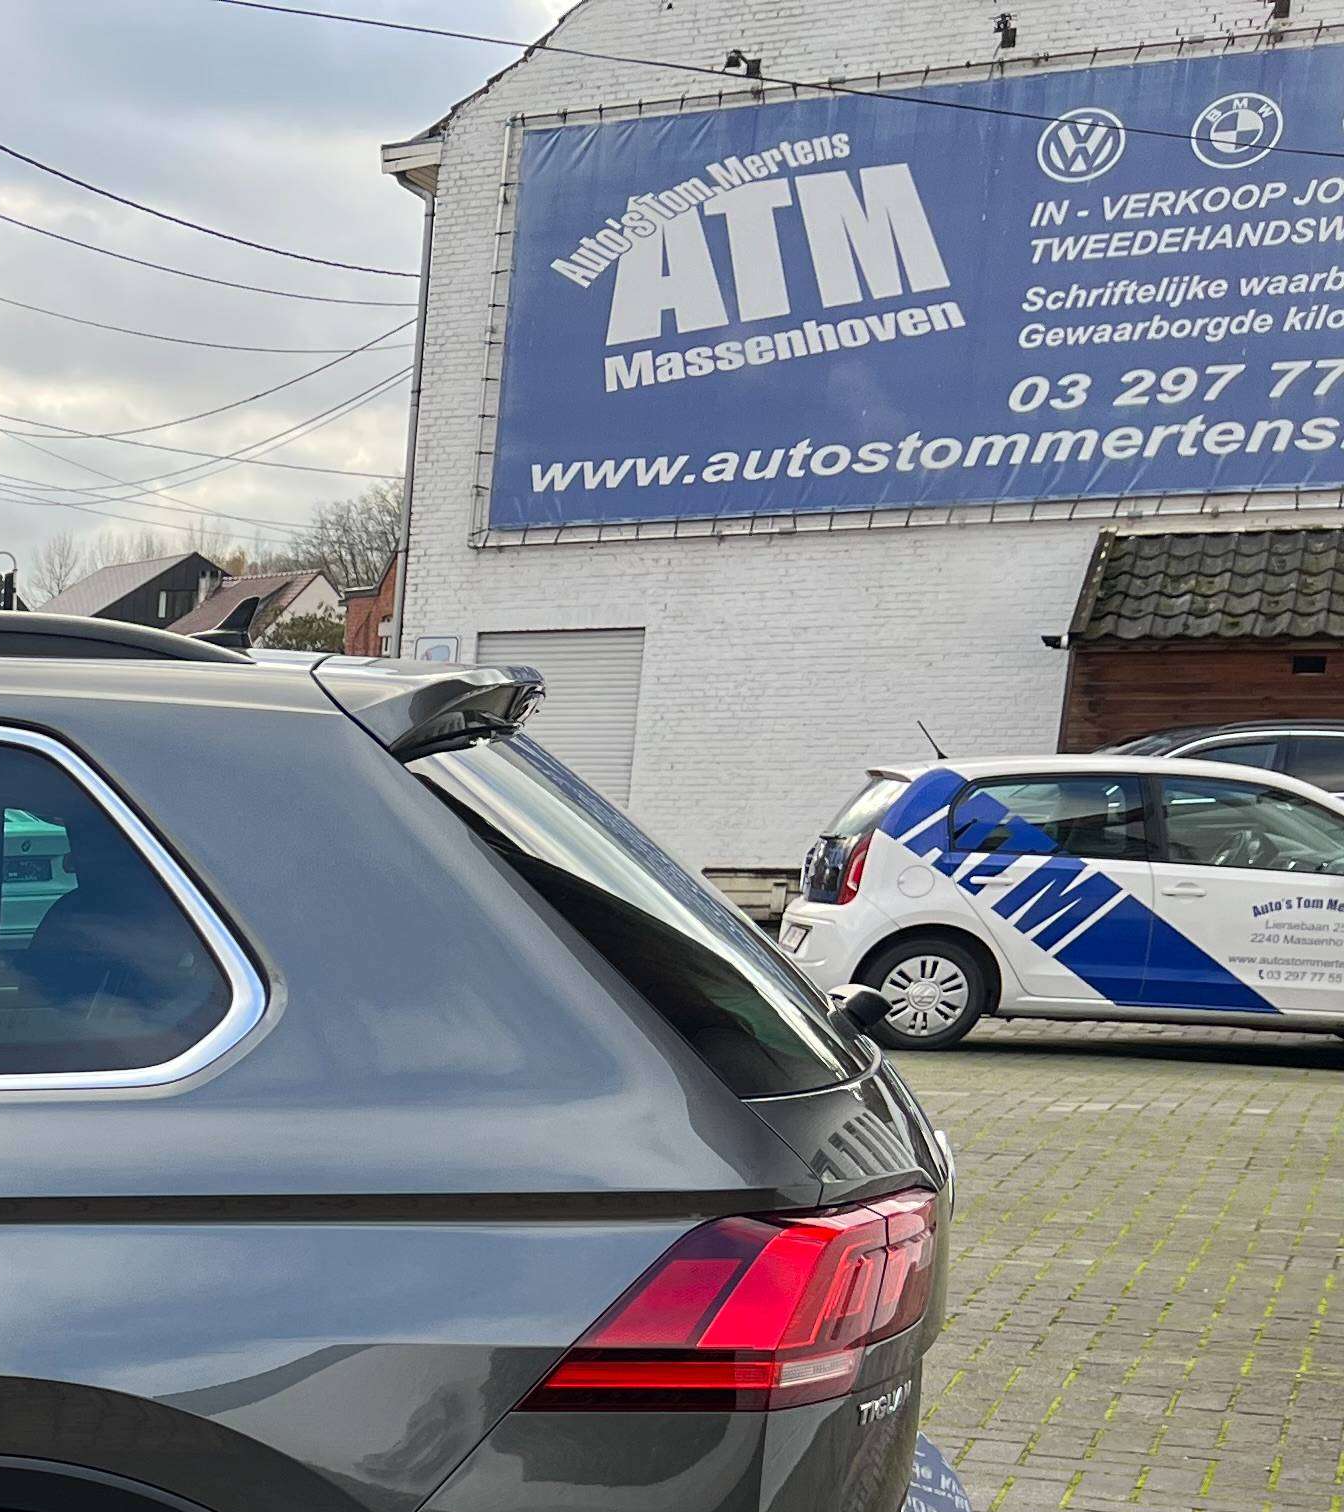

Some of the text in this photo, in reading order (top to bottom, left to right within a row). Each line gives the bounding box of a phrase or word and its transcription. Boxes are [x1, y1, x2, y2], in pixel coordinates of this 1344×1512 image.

[549, 132, 851, 288] Auto's Tom Mertens
[1030, 200, 1069, 228] IN
[1102, 182, 1287, 222] VERKOOP
[1293, 177, 1344, 206] JO
[605, 162, 951, 346] ATM
[1030, 216, 1344, 264] TWEEDEHANDSW
[1021, 275, 1229, 312] Schriftelijke
[604, 300, 966, 392] Massenhoven
[1018, 308, 1274, 350] Gewaarborgde
[1008, 358, 1344, 413] 03 297 77
[1296, 897, 1323, 909] Tom
[1250, 933, 1280, 943] 2240
